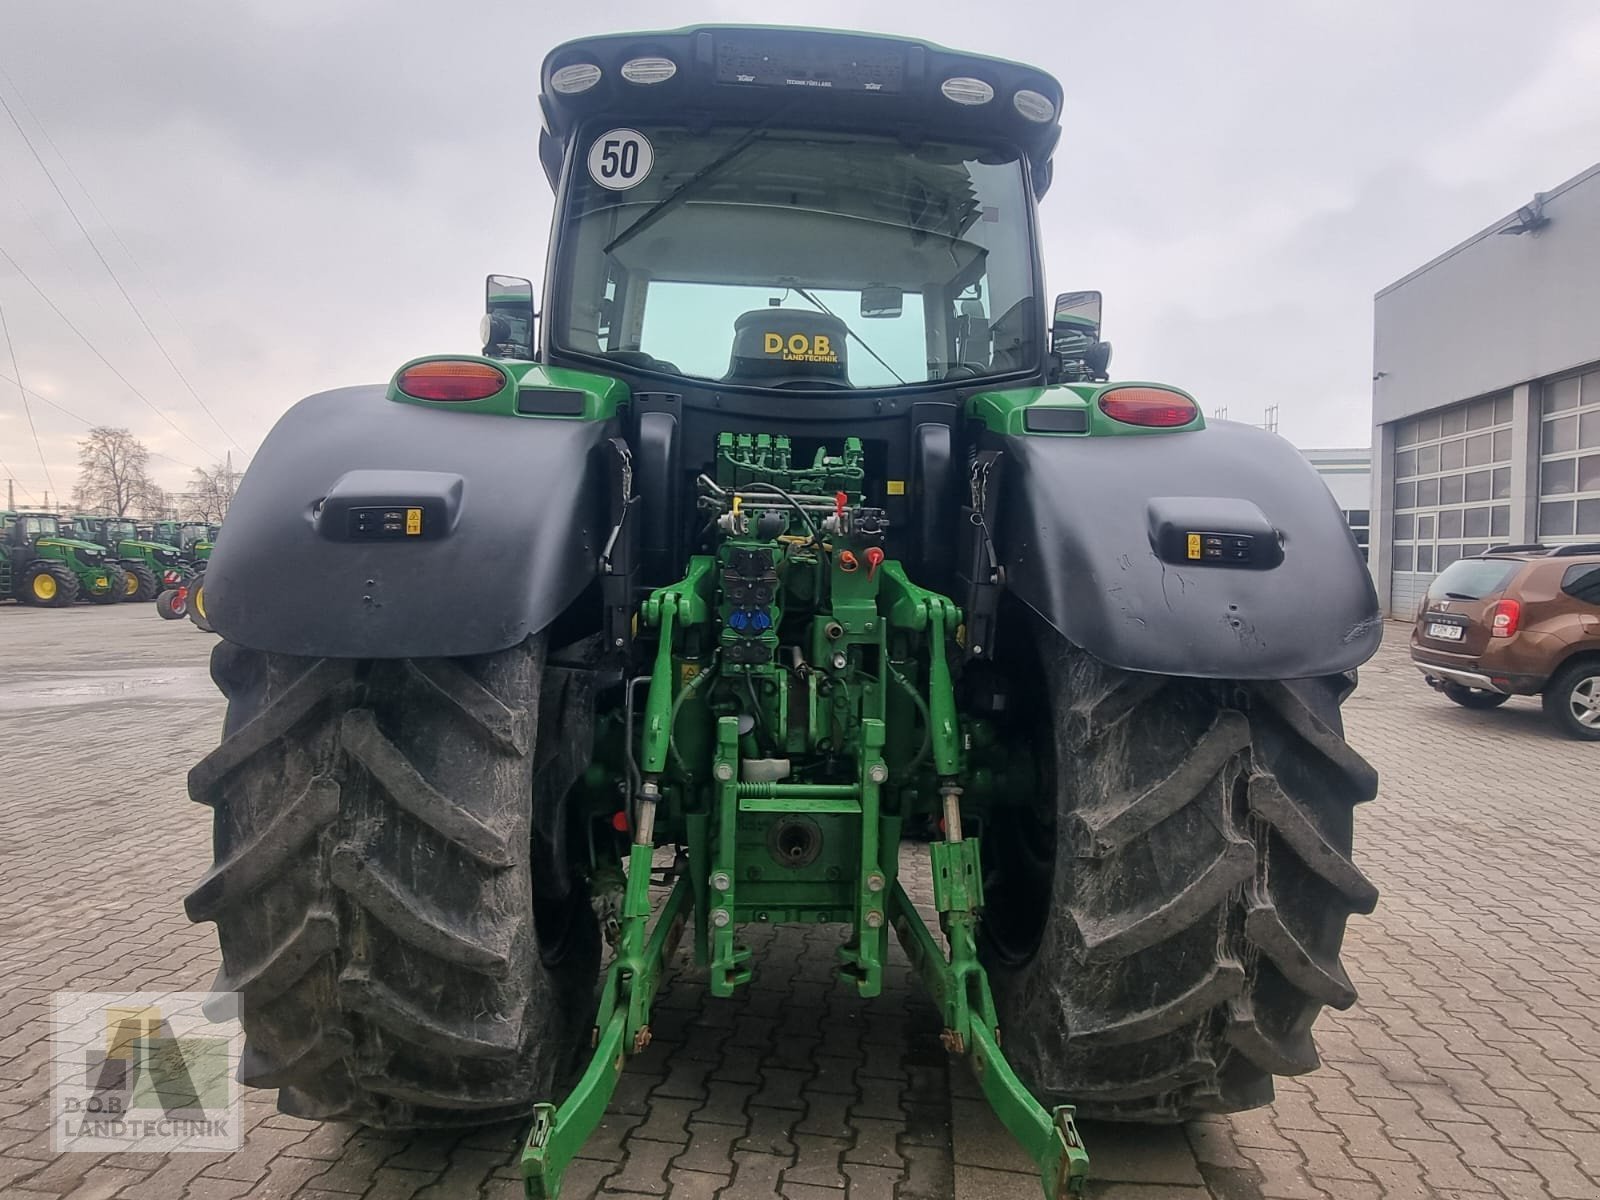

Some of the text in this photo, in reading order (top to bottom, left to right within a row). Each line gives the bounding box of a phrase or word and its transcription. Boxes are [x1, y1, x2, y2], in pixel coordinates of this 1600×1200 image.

[601, 140, 639, 178] 50
[764, 333, 835, 355] D.O.B.
[783, 354, 838, 363] LANDTECHNIK
